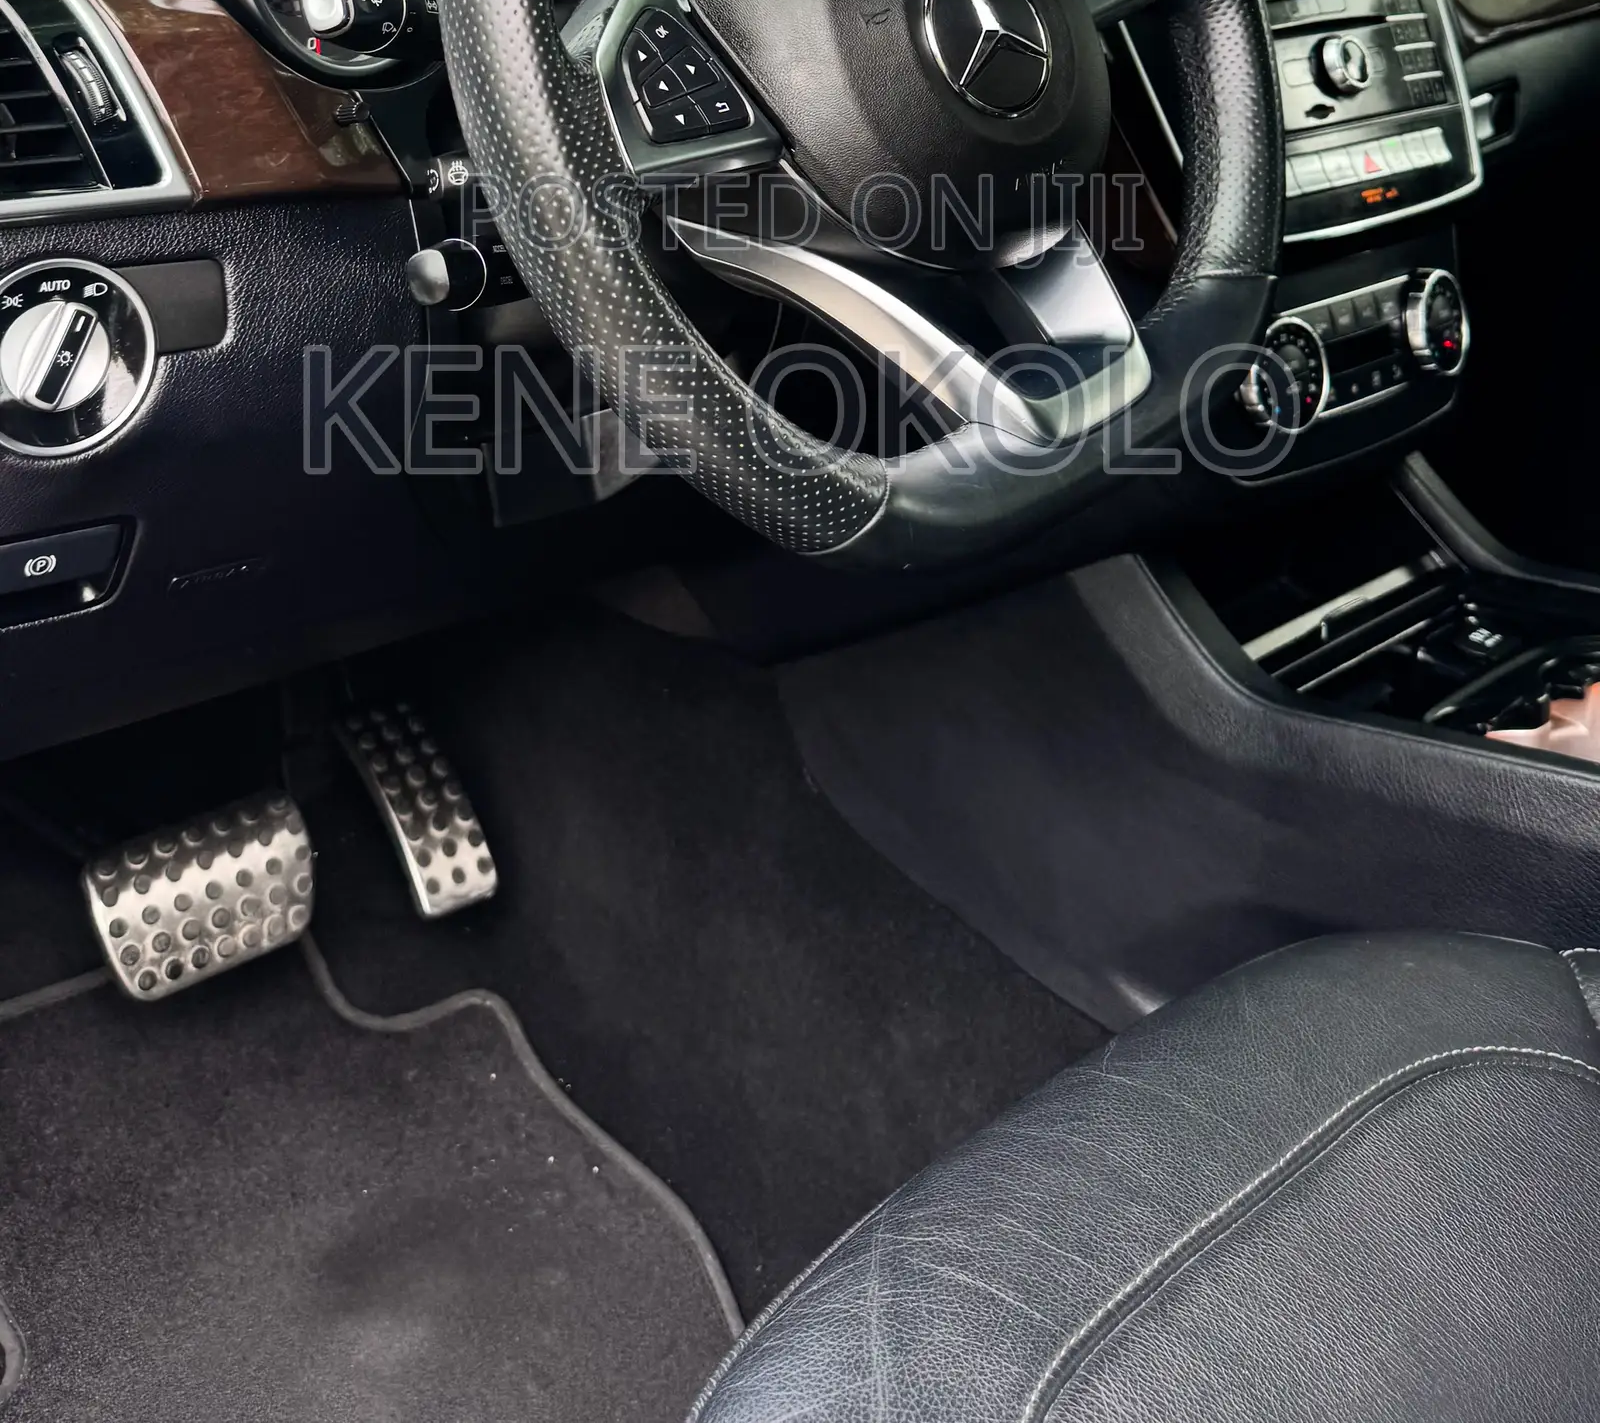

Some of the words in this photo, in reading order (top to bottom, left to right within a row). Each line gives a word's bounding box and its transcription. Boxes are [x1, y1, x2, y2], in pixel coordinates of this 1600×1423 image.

[655, 25, 669, 38] OK
[307, 37, 316, 50] 0
[39, 279, 71, 293] AUTO
